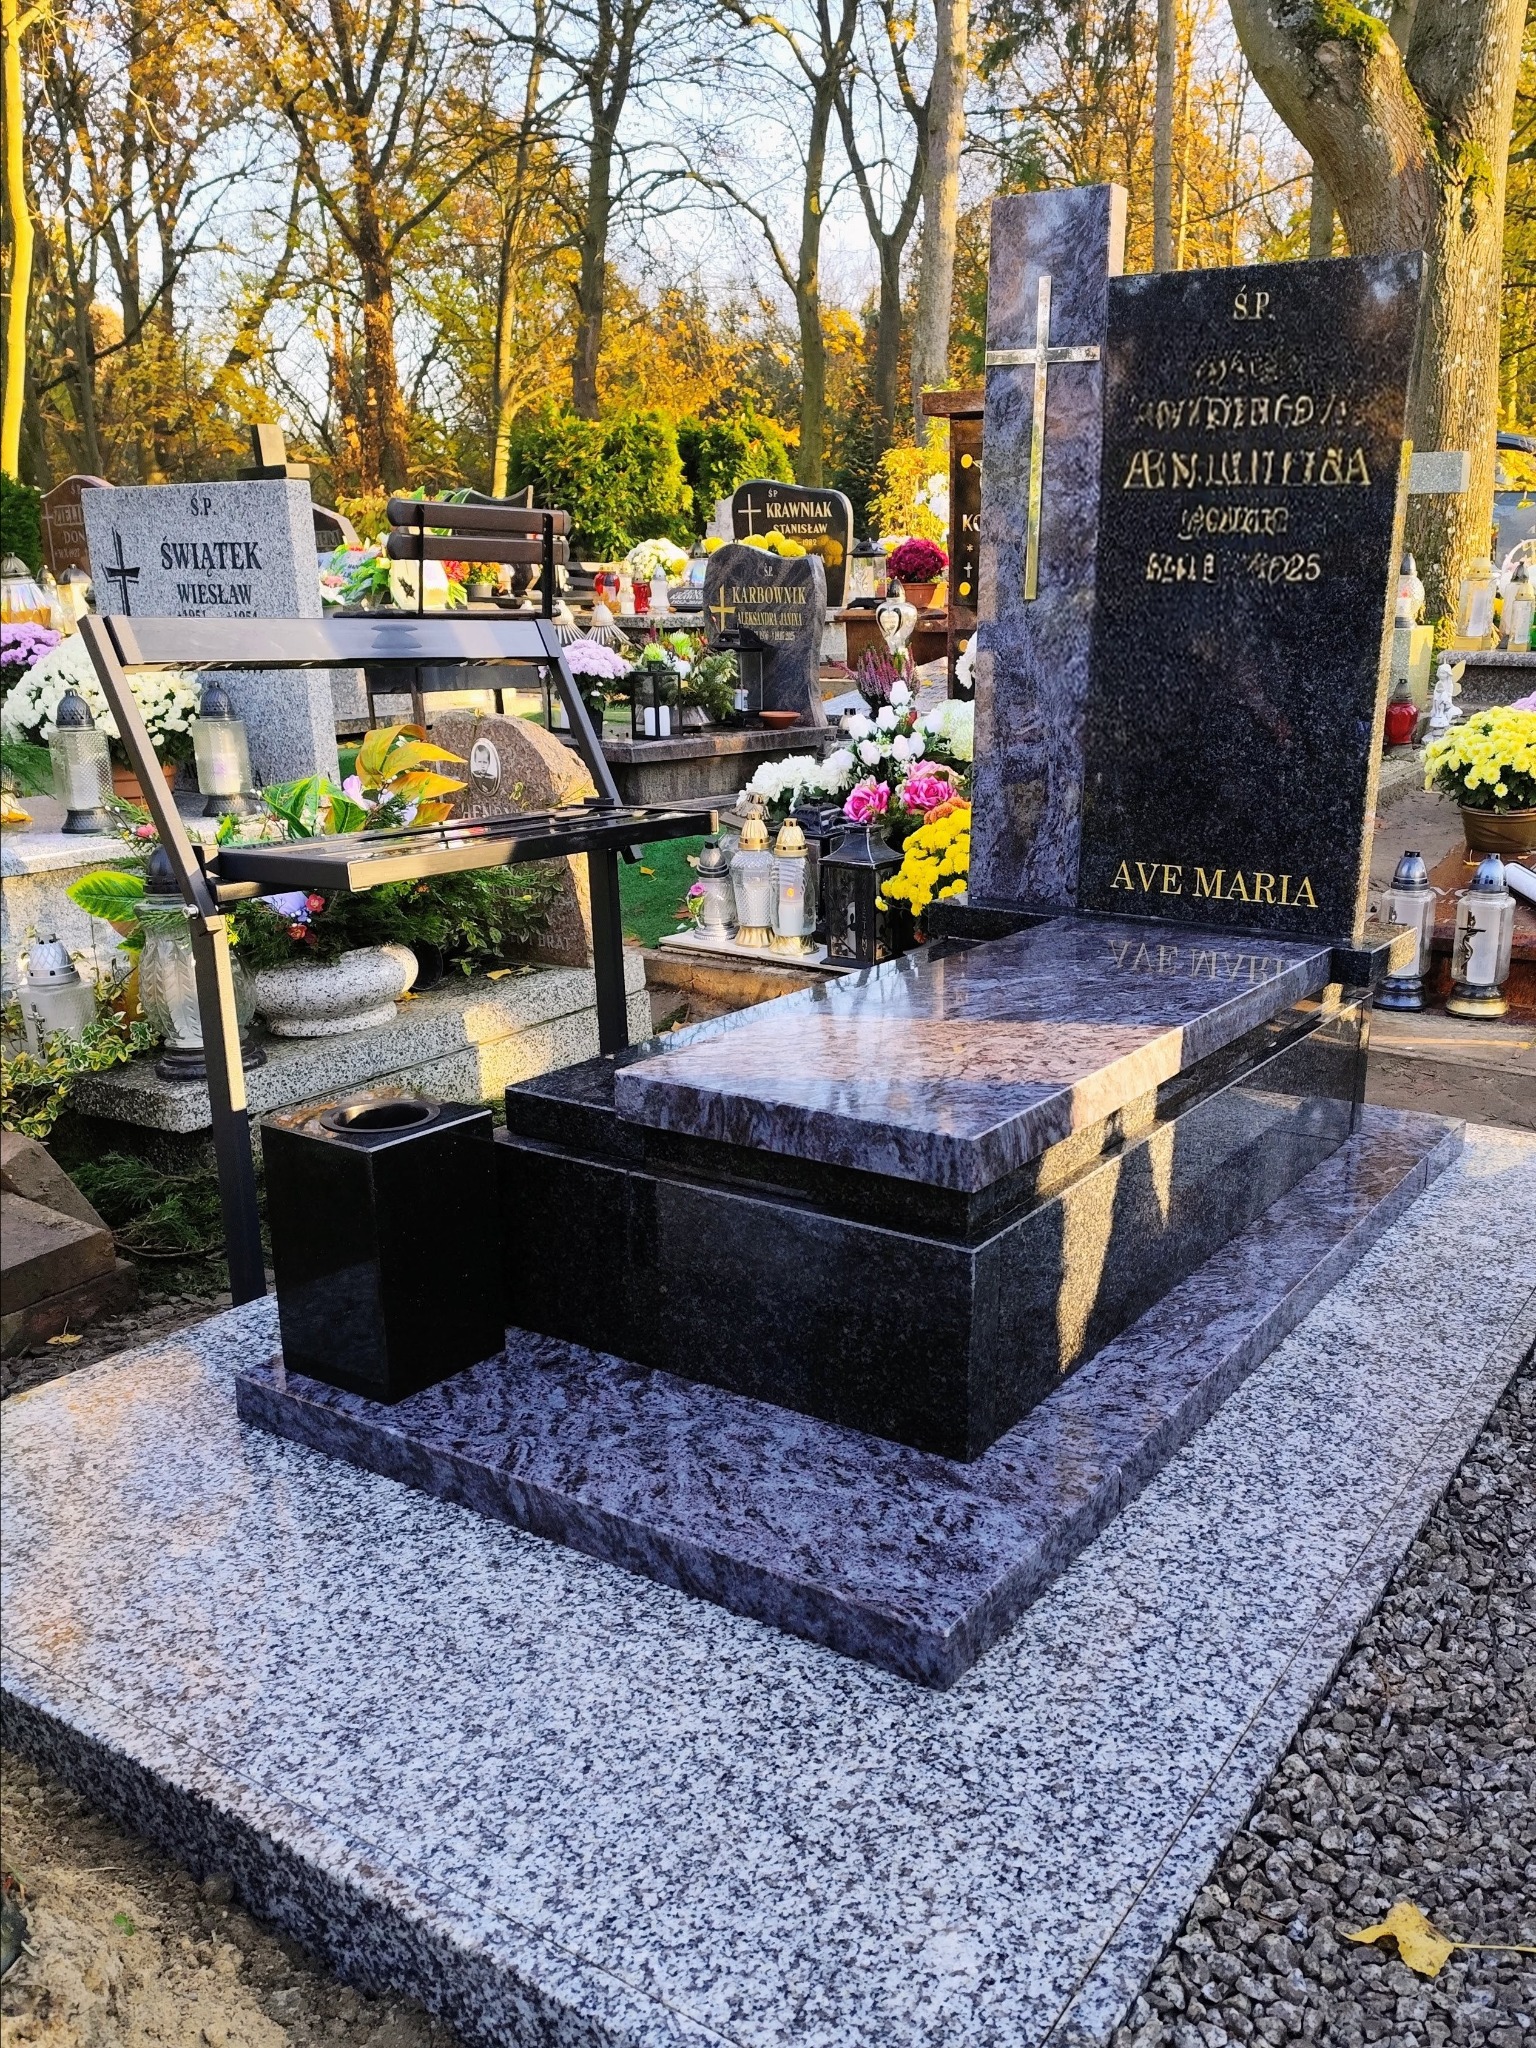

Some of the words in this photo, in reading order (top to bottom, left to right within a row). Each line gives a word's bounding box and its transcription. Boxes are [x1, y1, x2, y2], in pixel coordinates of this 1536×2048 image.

[766, 501, 833, 518] KRAWNIAK
[773, 523, 828, 535] STANISŁAW
[160, 535, 262, 577] ŚWIĄTEK
[176, 583, 252, 605] WIESŁAW
[732, 586, 806, 604] KARBOWNIK
[1110, 859, 1183, 896] AVE
[1192, 867, 1319, 908] MARIA
